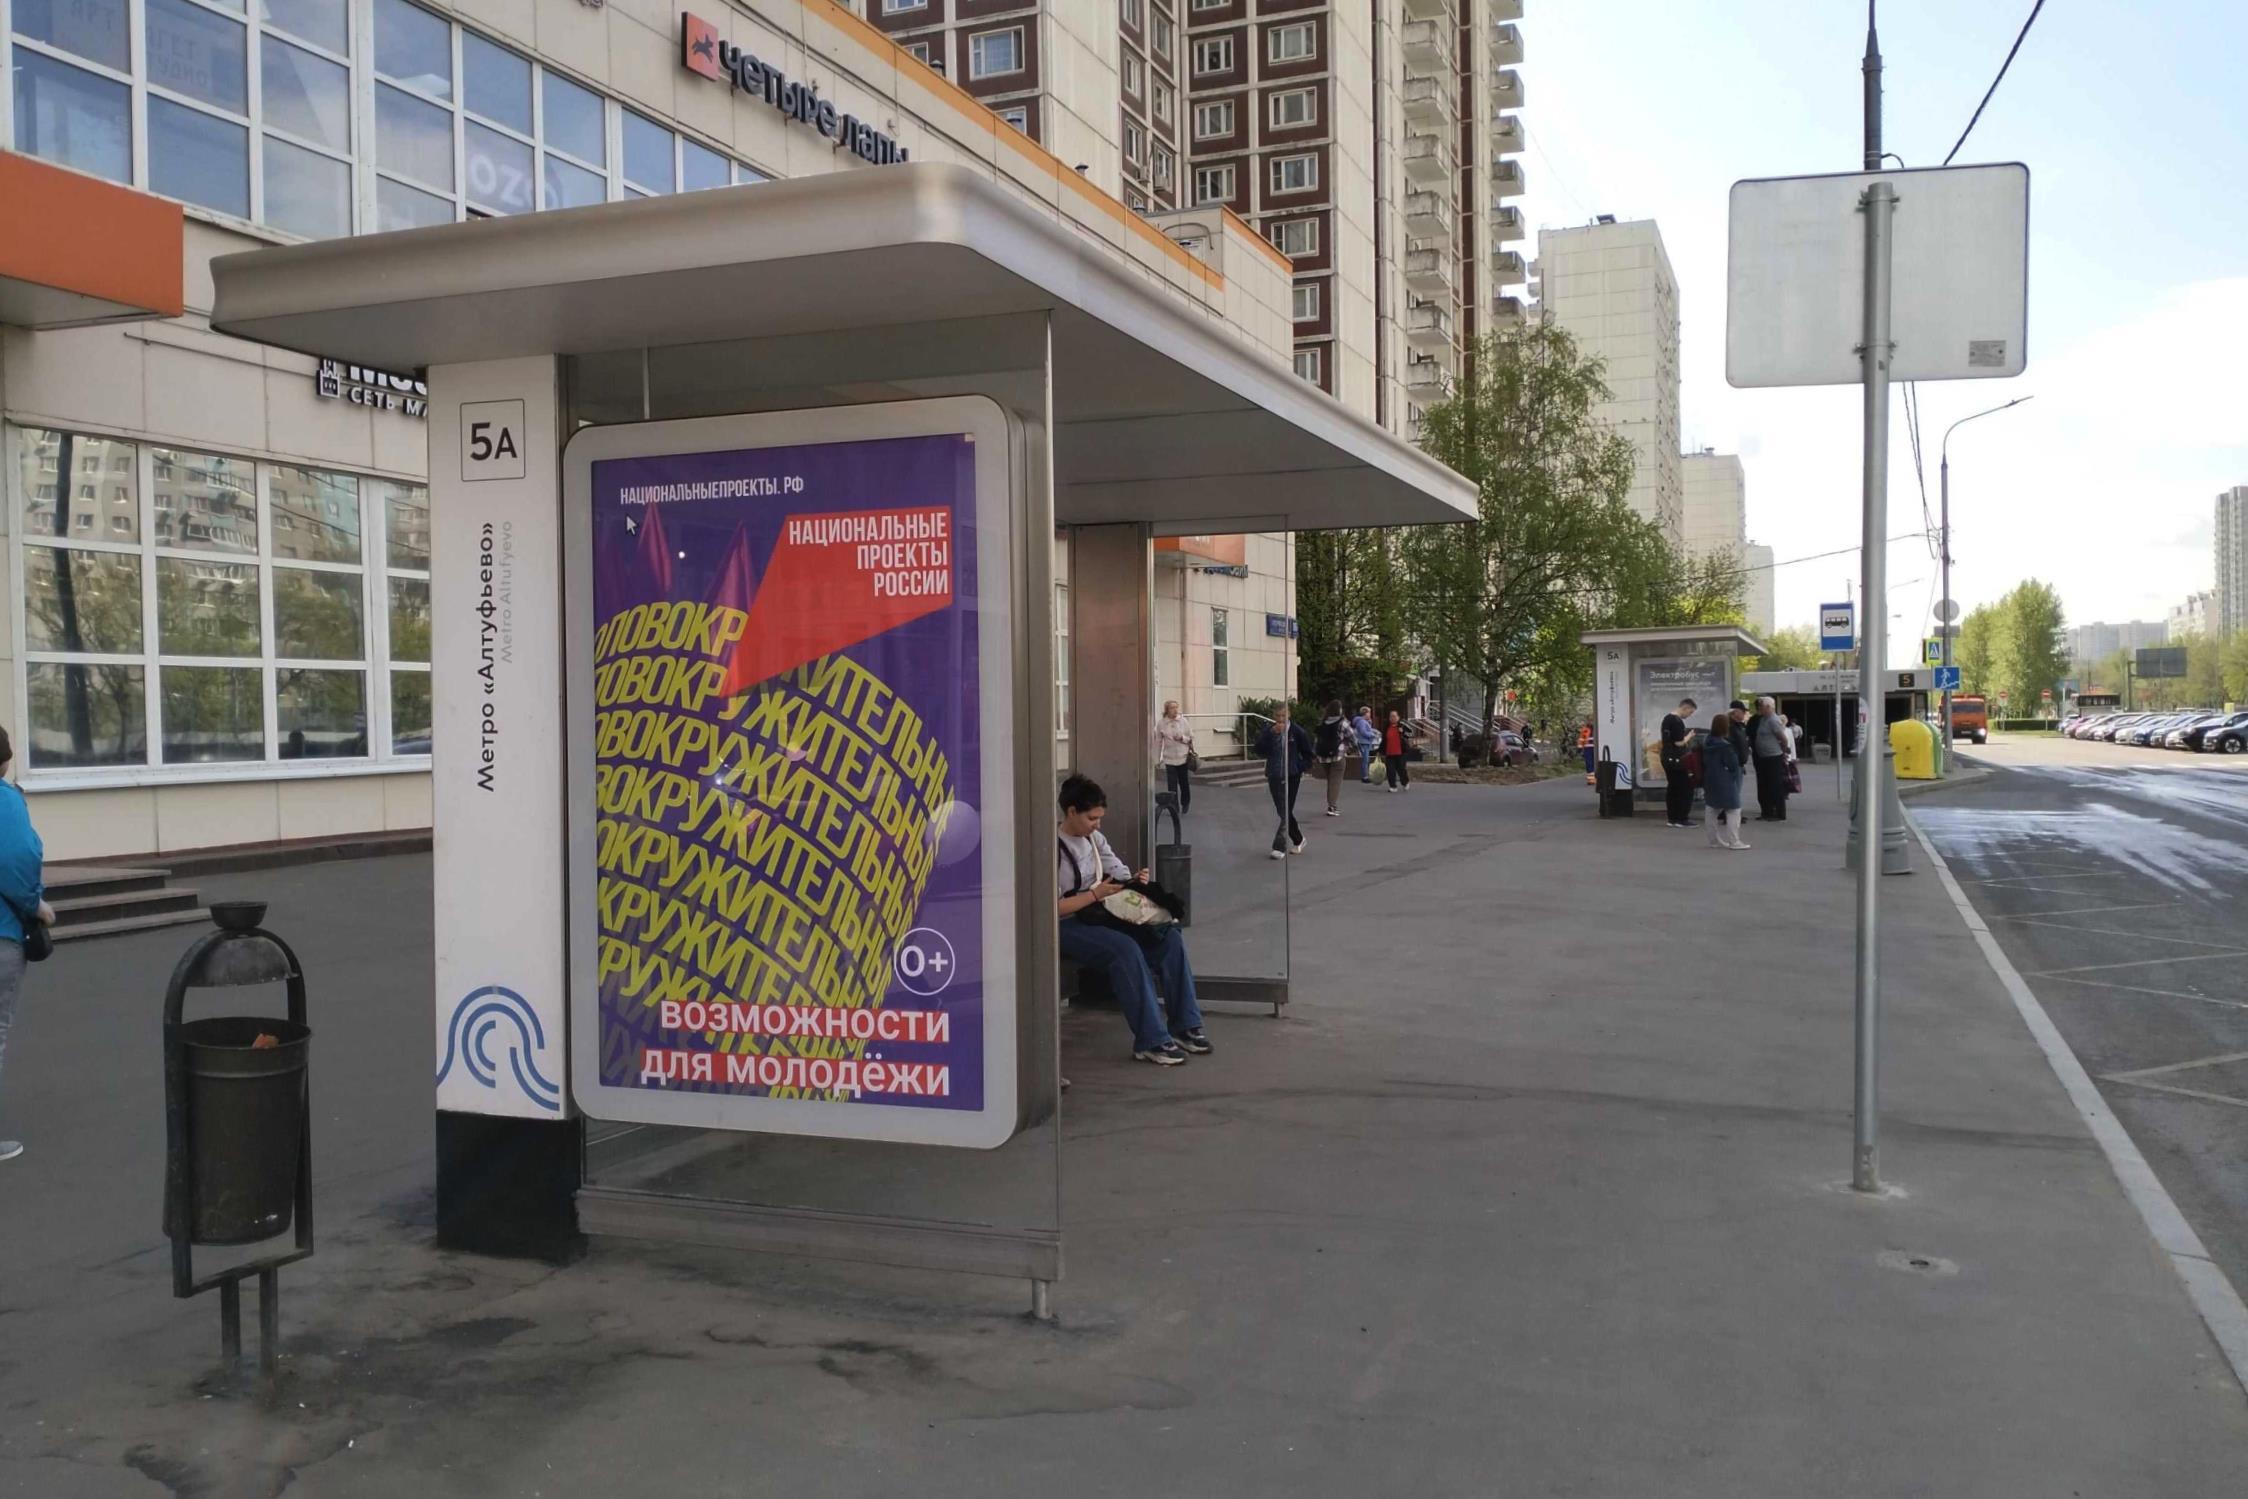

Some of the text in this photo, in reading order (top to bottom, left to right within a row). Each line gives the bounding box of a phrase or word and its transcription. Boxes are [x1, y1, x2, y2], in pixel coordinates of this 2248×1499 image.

[350, 387, 396, 410] СЕТЬ
[470, 422, 518, 461] 5А
[789, 512, 948, 547] НАЦИОНАЛЬНЫЕ
[857, 542, 948, 569] ПРОЕКТЫ
[500, 521, 514, 663] Metro Altufyevo
[873, 570, 949, 597] РОССИИ
[475, 522, 498, 791] Метро «Алтуфьево»
[900, 945, 949, 978] 0+
